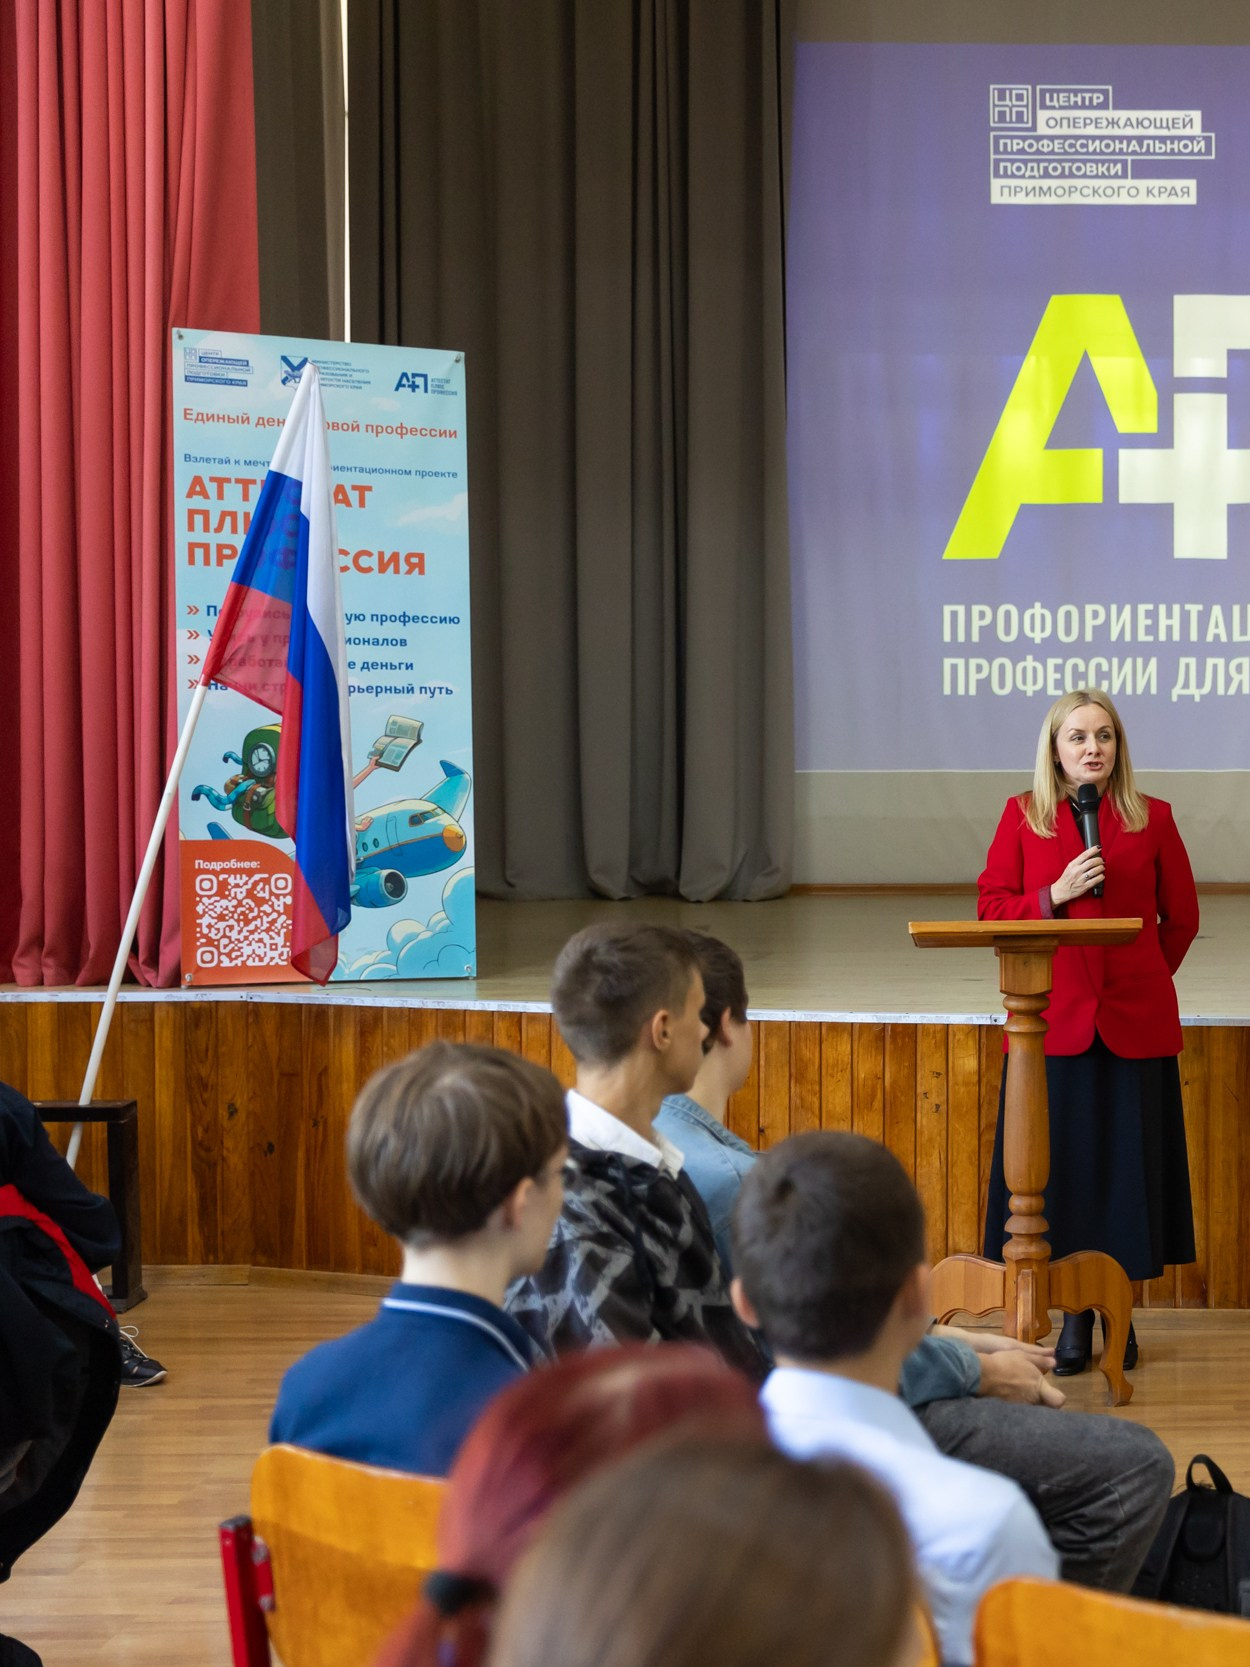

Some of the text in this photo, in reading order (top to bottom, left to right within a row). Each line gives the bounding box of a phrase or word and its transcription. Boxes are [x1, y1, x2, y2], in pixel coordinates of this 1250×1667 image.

[1045, 92, 1105, 109] ЦЕНТР
[1045, 113, 1194, 131] ОПЕРЕЖАЮЩЕЙ
[999, 136, 1206, 154] ПРОФЕССИОНАЛЬНОЙ
[999, 161, 1122, 178] ПОДГОТОВКИ
[1000, 184, 1191, 199] ПРИМОРСКОГО КРАЯ
[183, 407, 457, 439] Единый ден вой профессии
[184, 453, 458, 479] Взлетай к мечт иентационном проекте
[370, 611, 461, 627] профессию
[360, 661, 414, 672] деньги
[942, 655, 1158, 697] ПРОФЕССИИ
[1171, 657, 1250, 702] ДЛЯ
[348, 683, 415, 697] рьерный
[419, 686, 454, 698] путь
[195, 859, 261, 871] Подробнее:
